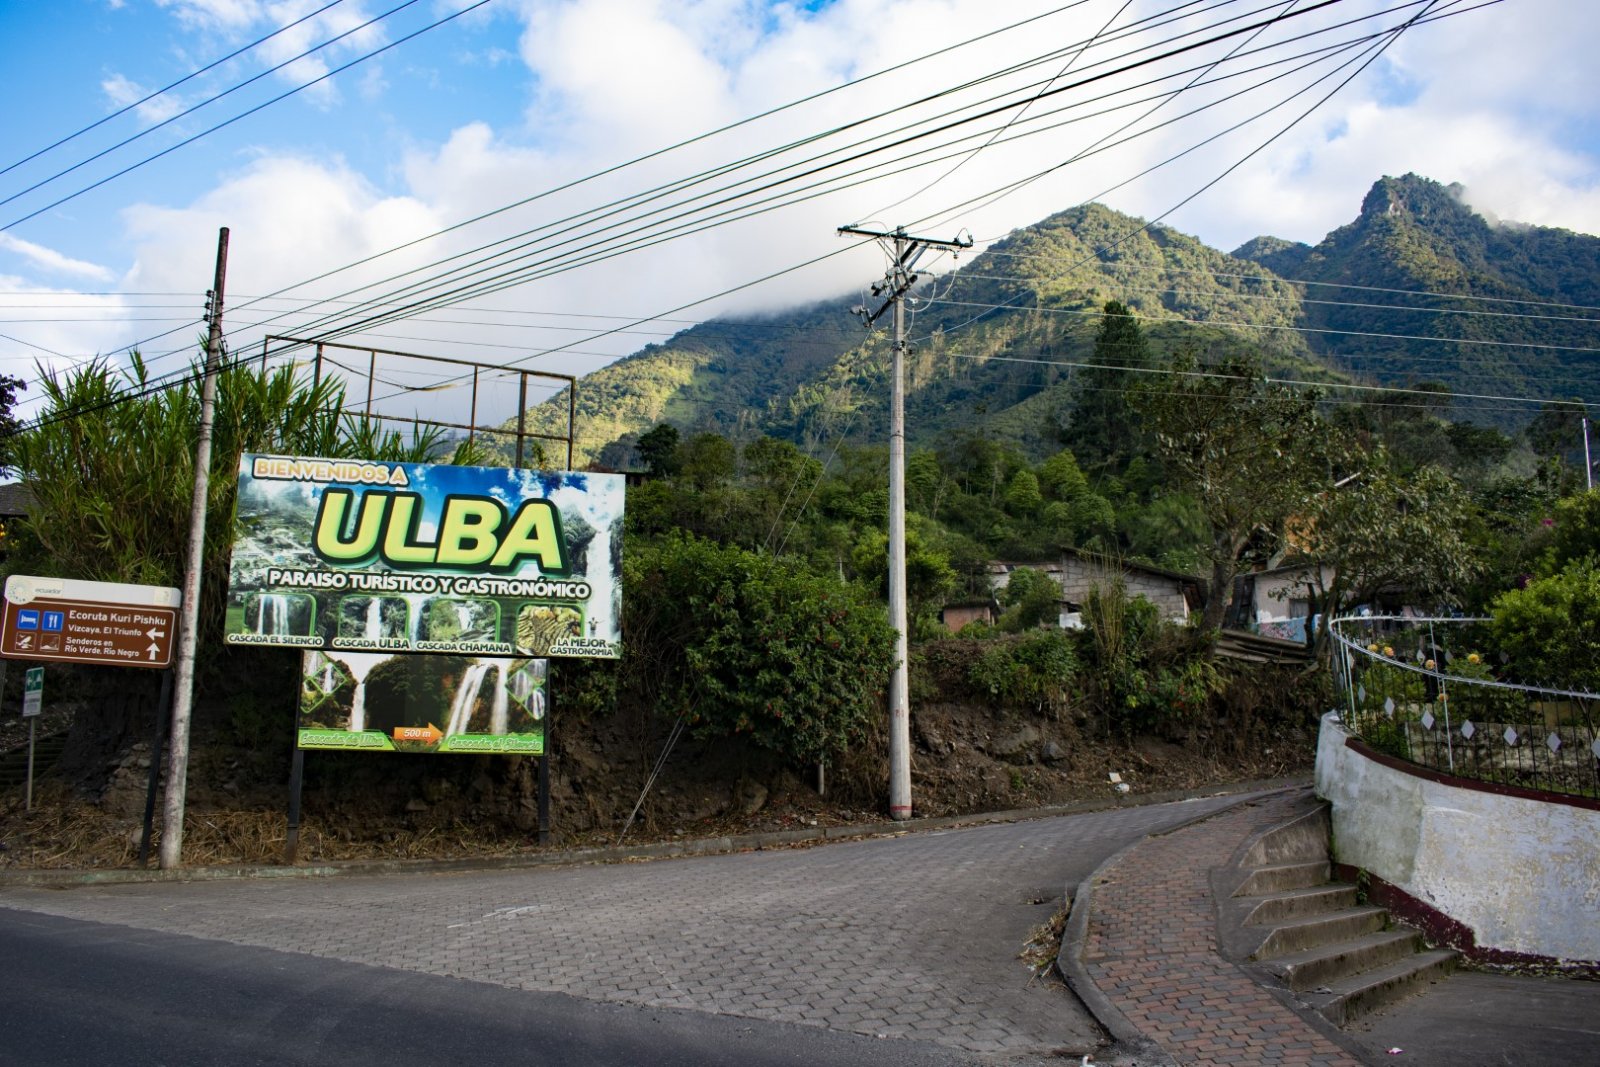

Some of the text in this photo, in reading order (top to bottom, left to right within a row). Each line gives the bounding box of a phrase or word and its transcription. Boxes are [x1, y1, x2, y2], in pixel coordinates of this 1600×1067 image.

[255, 459, 408, 485] BIENVENIDOS A
[315, 490, 566, 571] ULBA
[268, 571, 591, 599] PARAISO TURÍSTICO Y GASTRONÓMICO
[69, 610, 166, 626] Ecoruta Kuri Pishku
[103, 626, 112, 634] El
[113, 627, 142, 637] Triunfo
[66, 637, 102, 646] Senderos
[229, 634, 323, 646] CASCADA EL SILENCIO
[333, 638, 410, 649] CASCADA ULBA
[557, 638, 607, 648] LA MEJOR
[416, 641, 511, 653] CASCADA CHAMANA
[550, 647, 613, 656] GASTRONOMIA
[117, 648, 140, 659] Negro
[301, 732, 344, 745] Cascada
[404, 729, 421, 737] 500
[448, 737, 491, 749] Cascada
